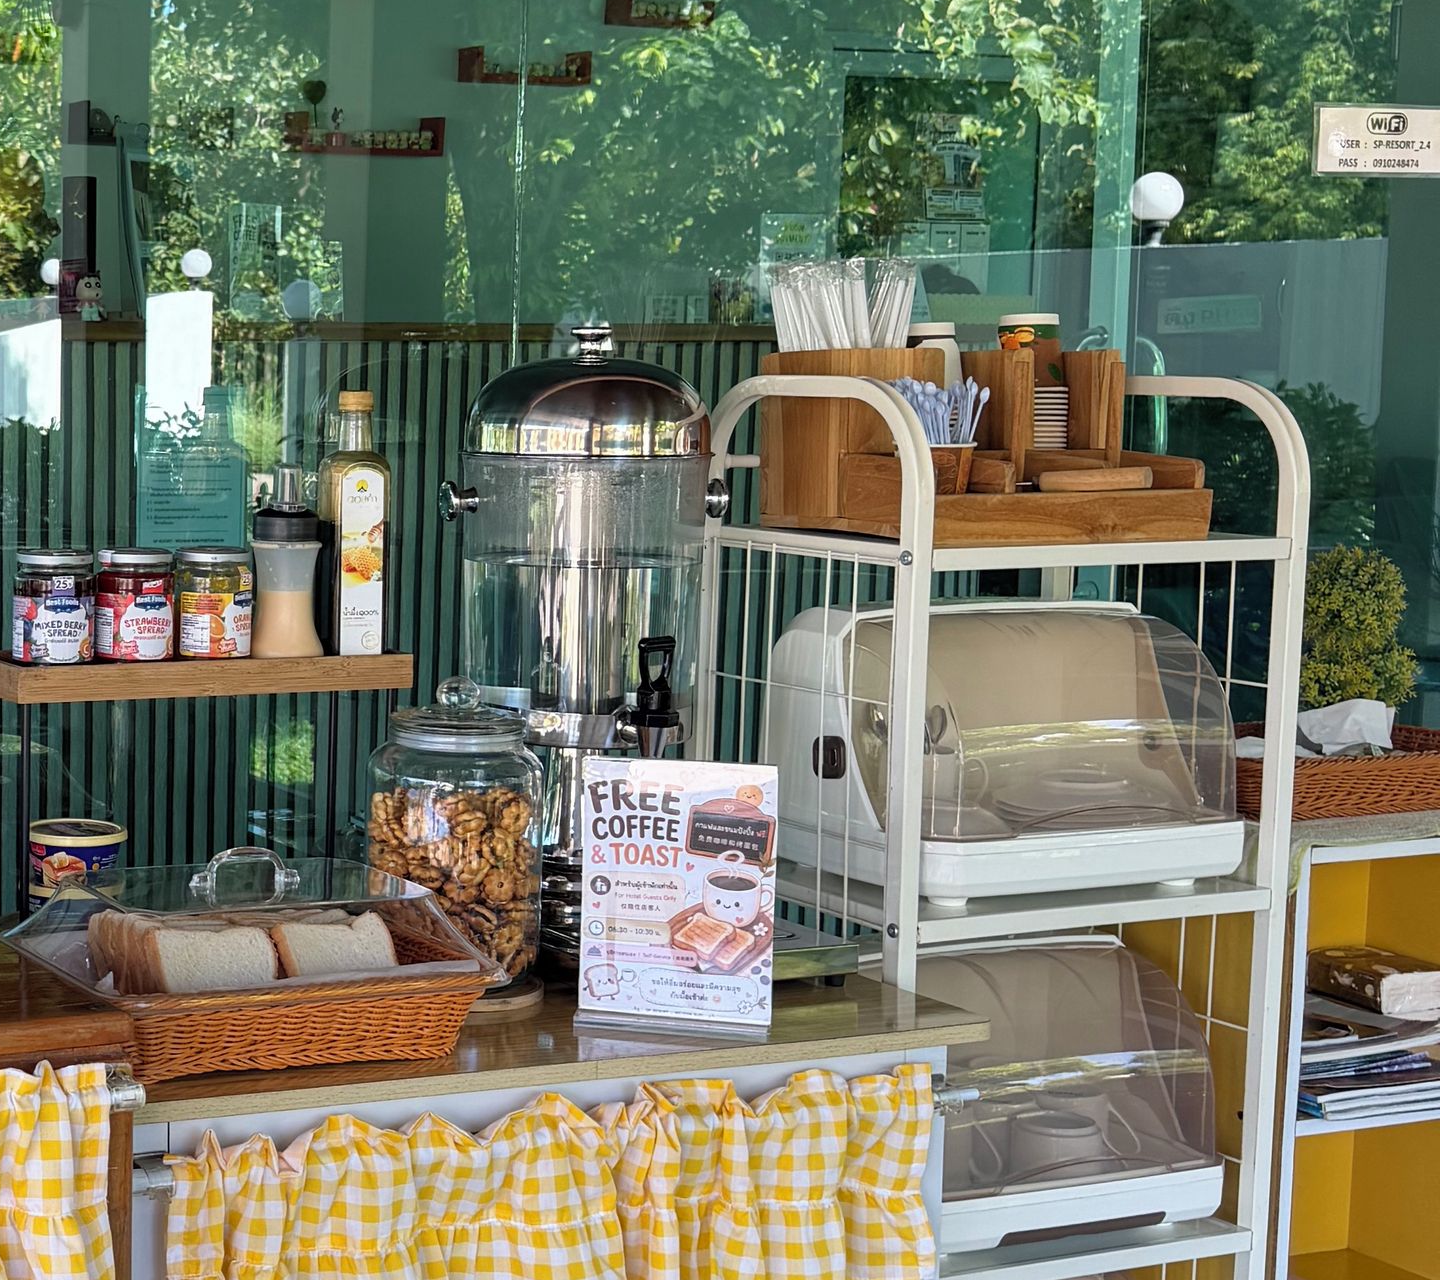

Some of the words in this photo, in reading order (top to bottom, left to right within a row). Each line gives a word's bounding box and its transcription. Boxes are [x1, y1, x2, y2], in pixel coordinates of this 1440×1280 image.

[1338, 158, 1358, 168] PASS
[34, 621, 63, 630] MIXED
[64, 620, 87, 630] BERRY
[124, 616, 172, 627] STRAWBERRY
[47, 630, 78, 638] SPREAD
[137, 626, 165, 634] SPREAD
[587, 778, 684, 815] FREE
[592, 815, 681, 842] COFFEE
[591, 844, 606, 864] &
[608, 842, 683, 868] TOAST
